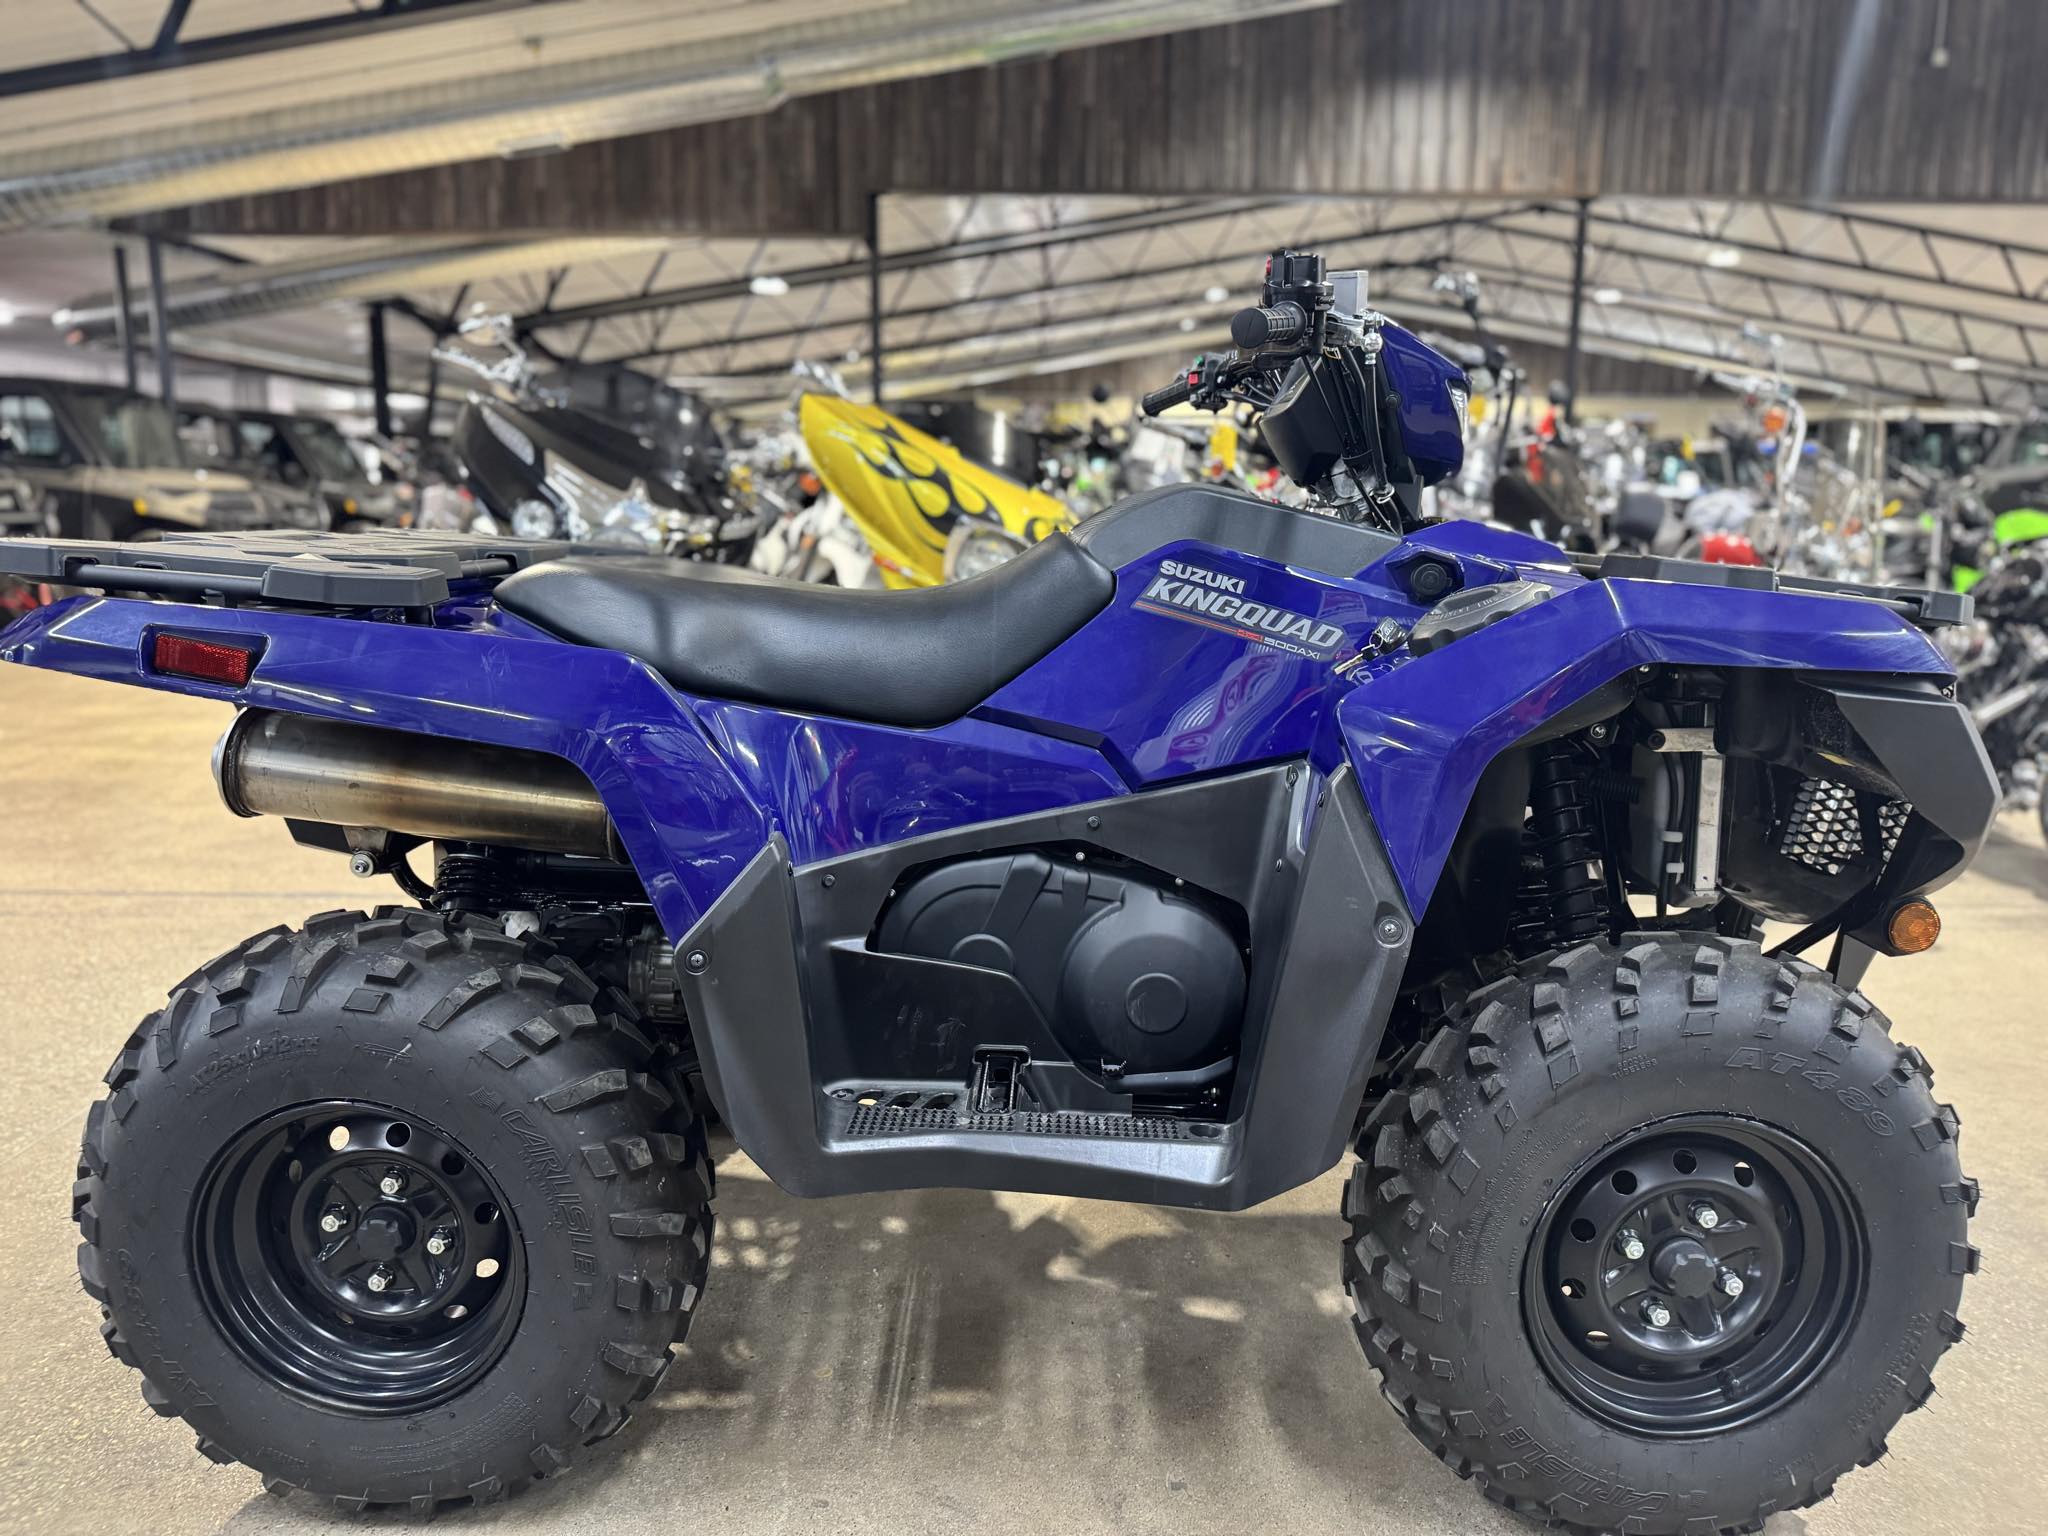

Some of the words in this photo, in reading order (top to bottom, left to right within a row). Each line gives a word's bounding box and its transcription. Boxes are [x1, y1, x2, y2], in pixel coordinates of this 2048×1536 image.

[1146, 577, 1345, 648] KINGQUAD
[1160, 560, 1247, 595] SUZUKI
[1264, 637, 1320, 660] 500AXI
[1723, 1047, 1897, 1136] AT489
[501, 1110, 597, 1276] CARLISLE
[1500, 1426, 1669, 1513] CARLISLE
